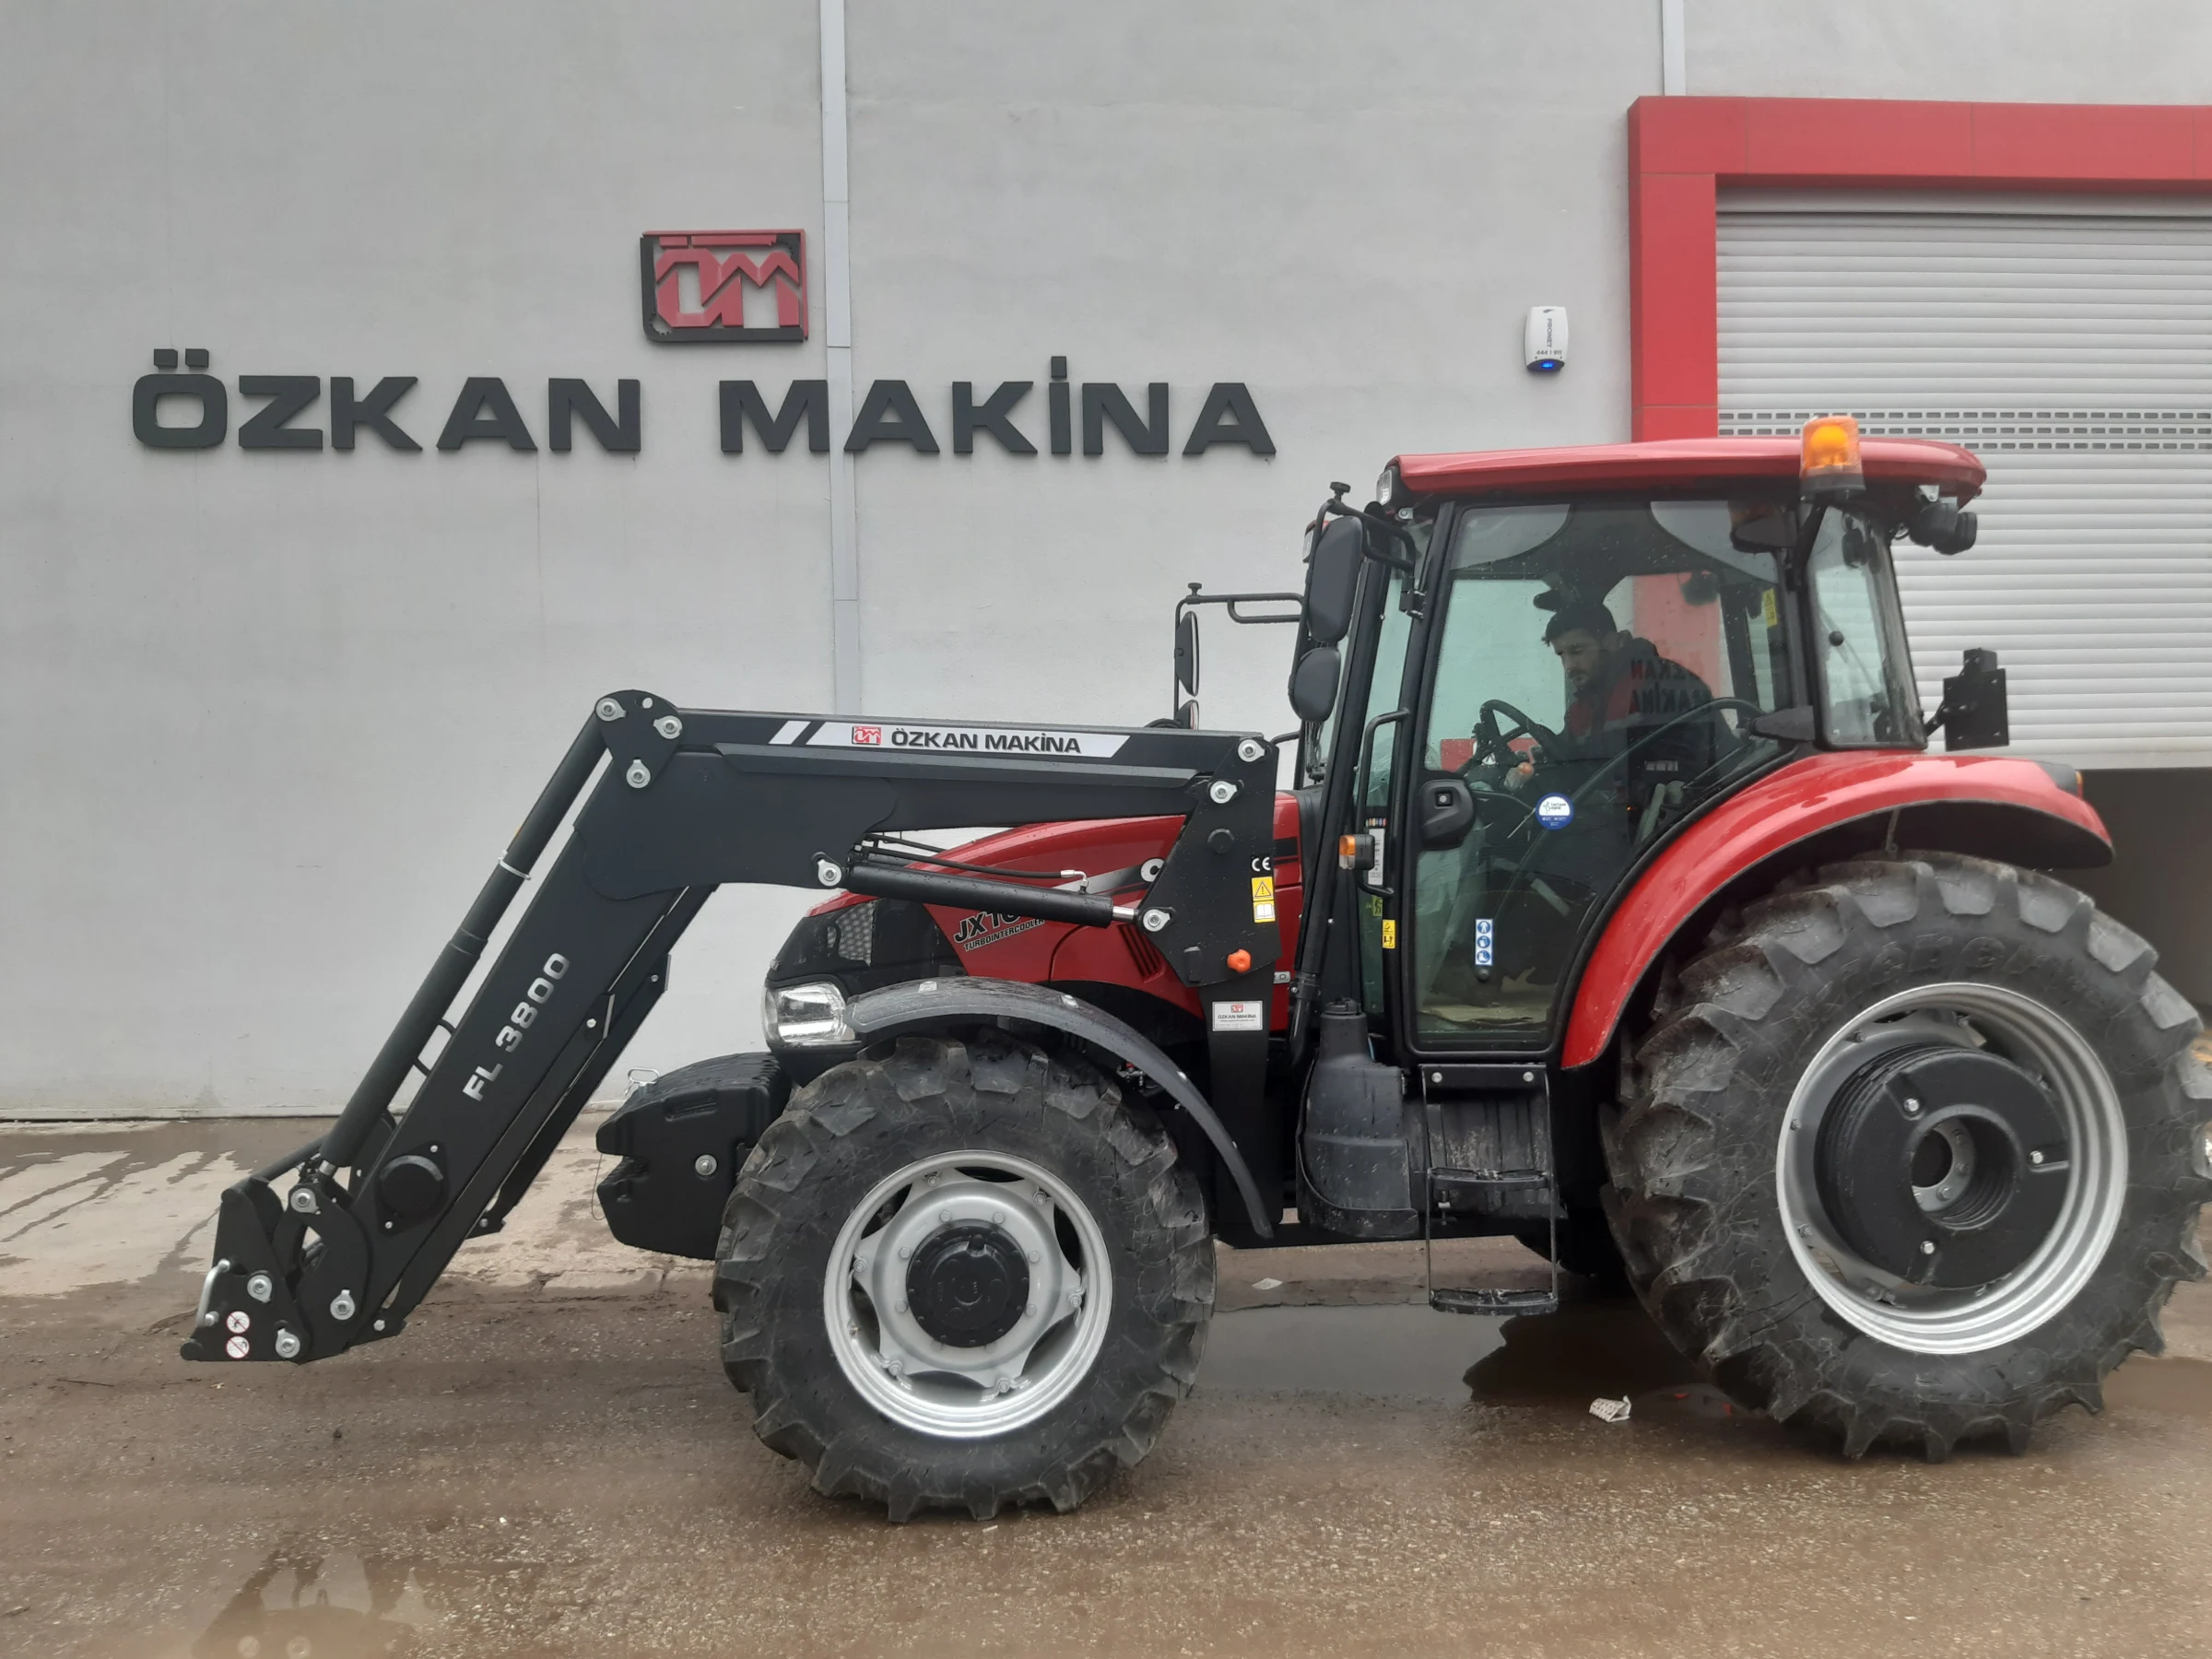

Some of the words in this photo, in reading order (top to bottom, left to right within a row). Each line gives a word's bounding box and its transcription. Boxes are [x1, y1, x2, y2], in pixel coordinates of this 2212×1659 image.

[132, 348, 641, 452] ÖZKAN
[719, 356, 1277, 455] MAKİNA
[890, 727, 980, 749] ÖZKAN
[984, 732, 1082, 754] MAKİNA
[1251, 856, 1271, 872] CE
[963, 918, 1045, 952] TURBOINTERCOOLER
[463, 1063, 503, 1101] FL
[495, 952, 571, 1053] 3800
